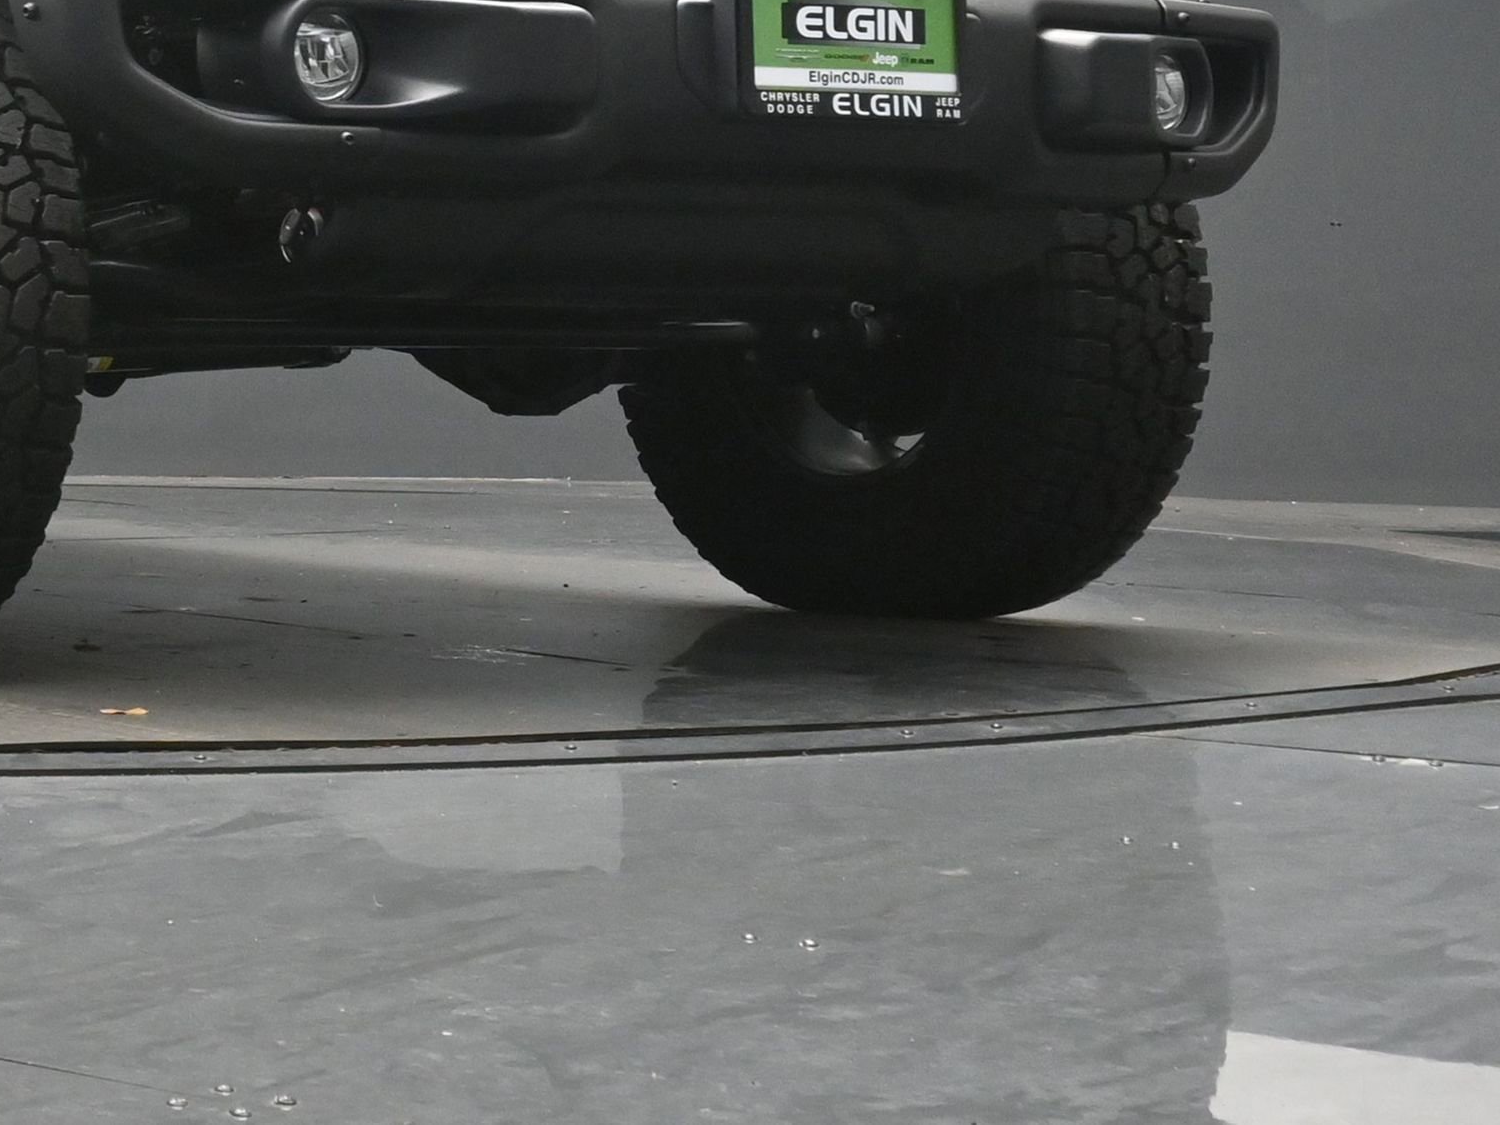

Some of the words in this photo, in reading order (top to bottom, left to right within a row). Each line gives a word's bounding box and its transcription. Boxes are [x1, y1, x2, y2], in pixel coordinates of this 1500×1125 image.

[796, 6, 914, 42] ELGIN
[872, 51, 899, 67] Jeep
[809, 71, 904, 86] ElginCDJR.com
[760, 91, 820, 103] CHRYSLER
[935, 97, 961, 108] JEEP
[767, 104, 814, 115] DODGE
[832, 93, 923, 118] ELGIN
[936, 108, 961, 119] RAM
